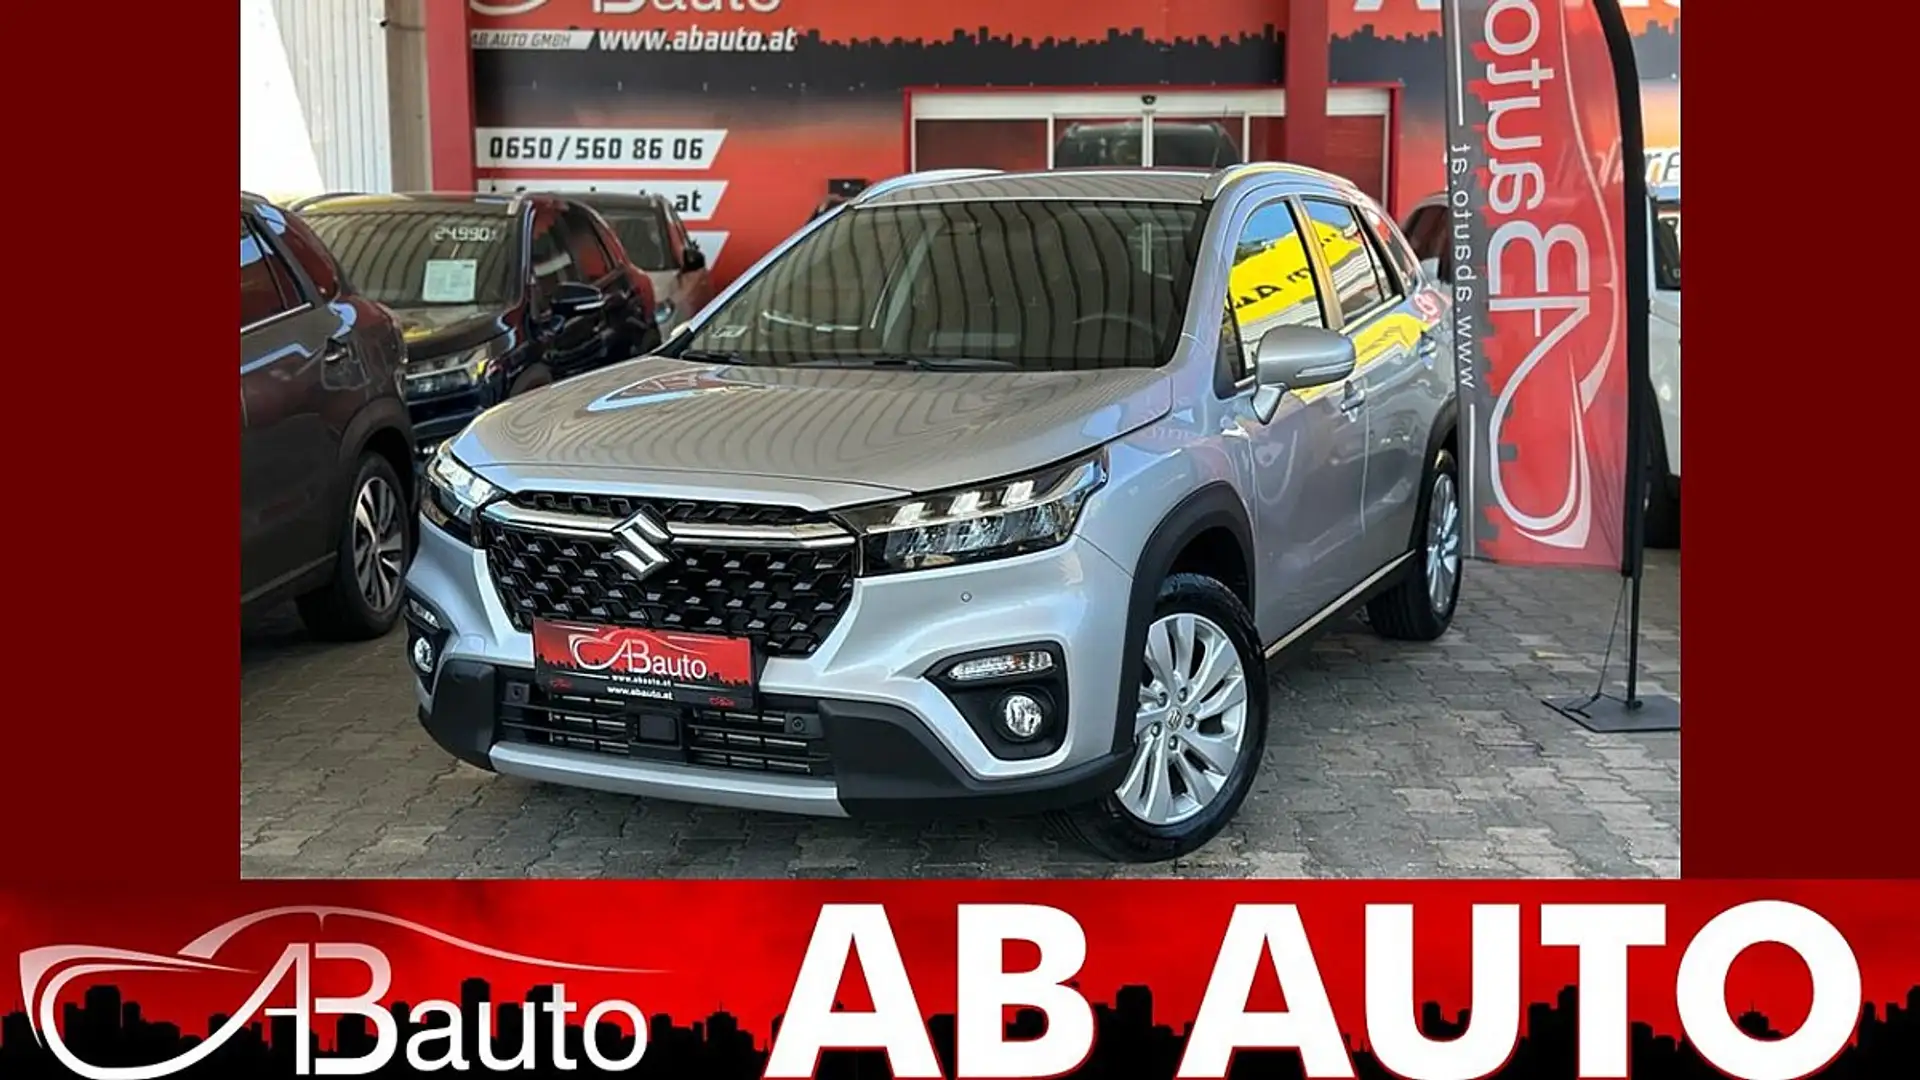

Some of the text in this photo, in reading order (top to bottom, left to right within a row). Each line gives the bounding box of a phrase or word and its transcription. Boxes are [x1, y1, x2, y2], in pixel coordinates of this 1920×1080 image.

[489, 33, 528, 47] AUTO
[531, 33, 571, 47] GMBH
[600, 24, 797, 51] www.abauto.at
[632, 137, 663, 160] 86
[673, 137, 703, 160] 06
[606, 686, 673, 701] www.abauto.at
